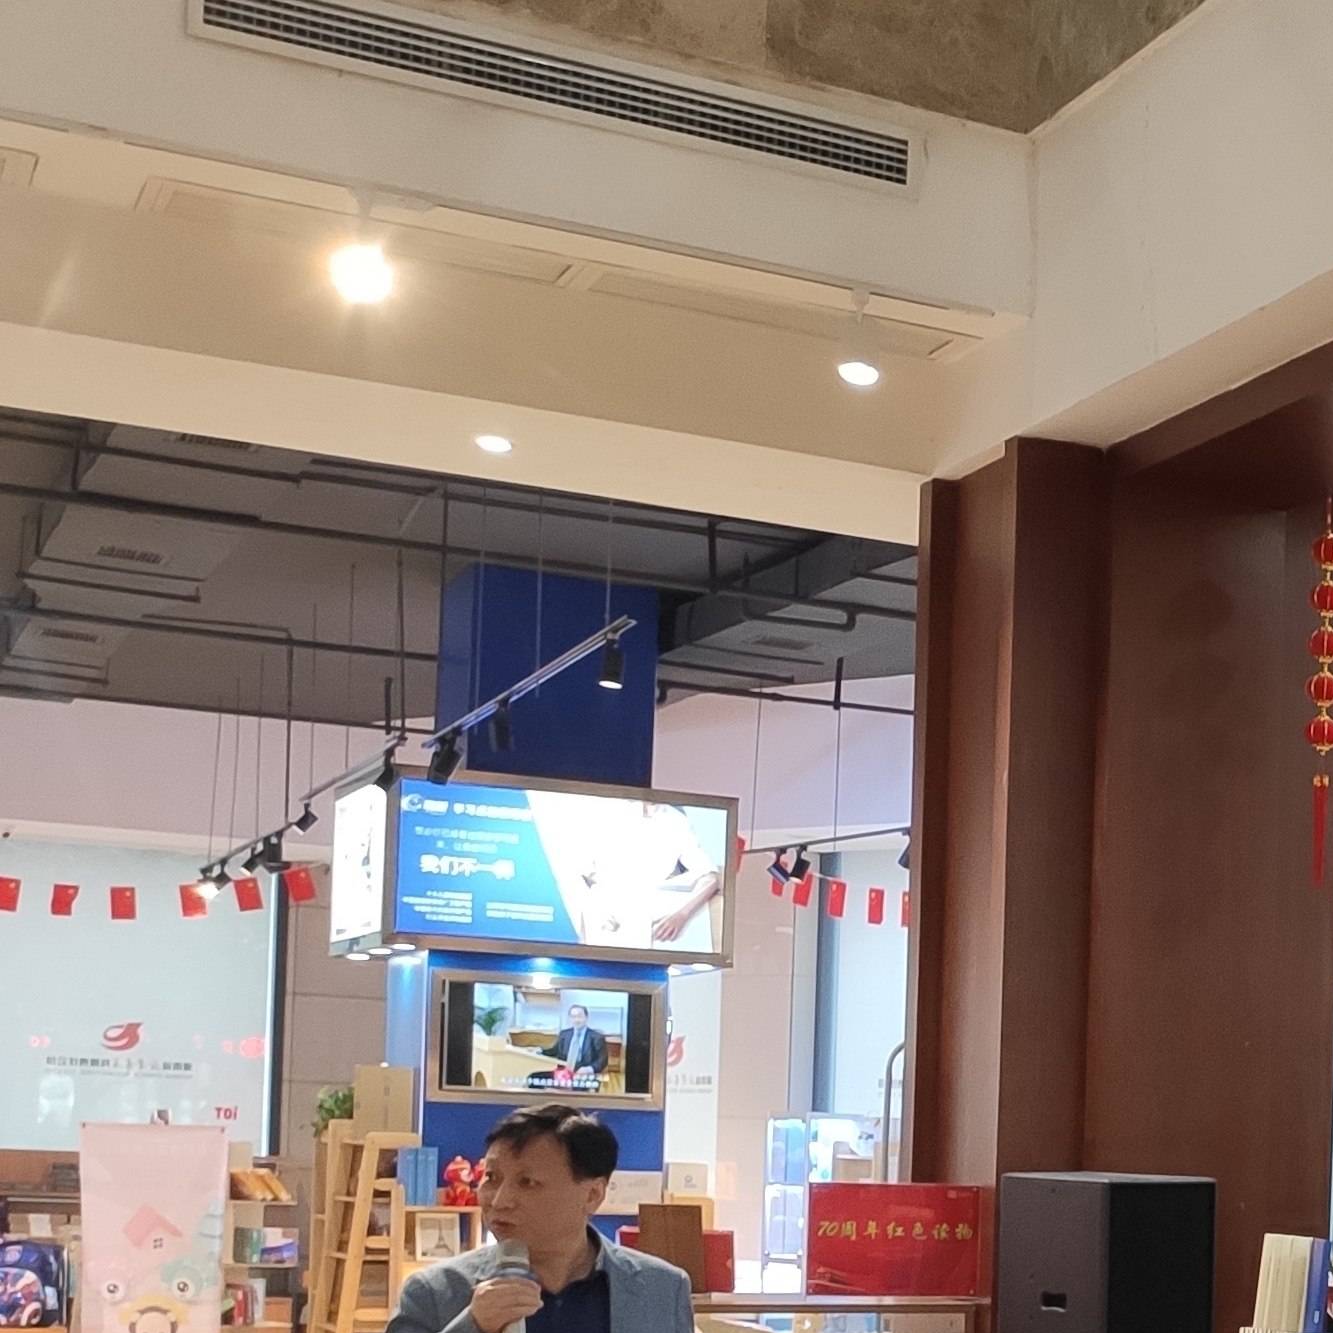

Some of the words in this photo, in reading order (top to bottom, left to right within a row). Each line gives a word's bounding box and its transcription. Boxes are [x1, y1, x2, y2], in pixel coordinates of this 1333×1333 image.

[817, 1220, 974, 1242] 70周年红色读物
